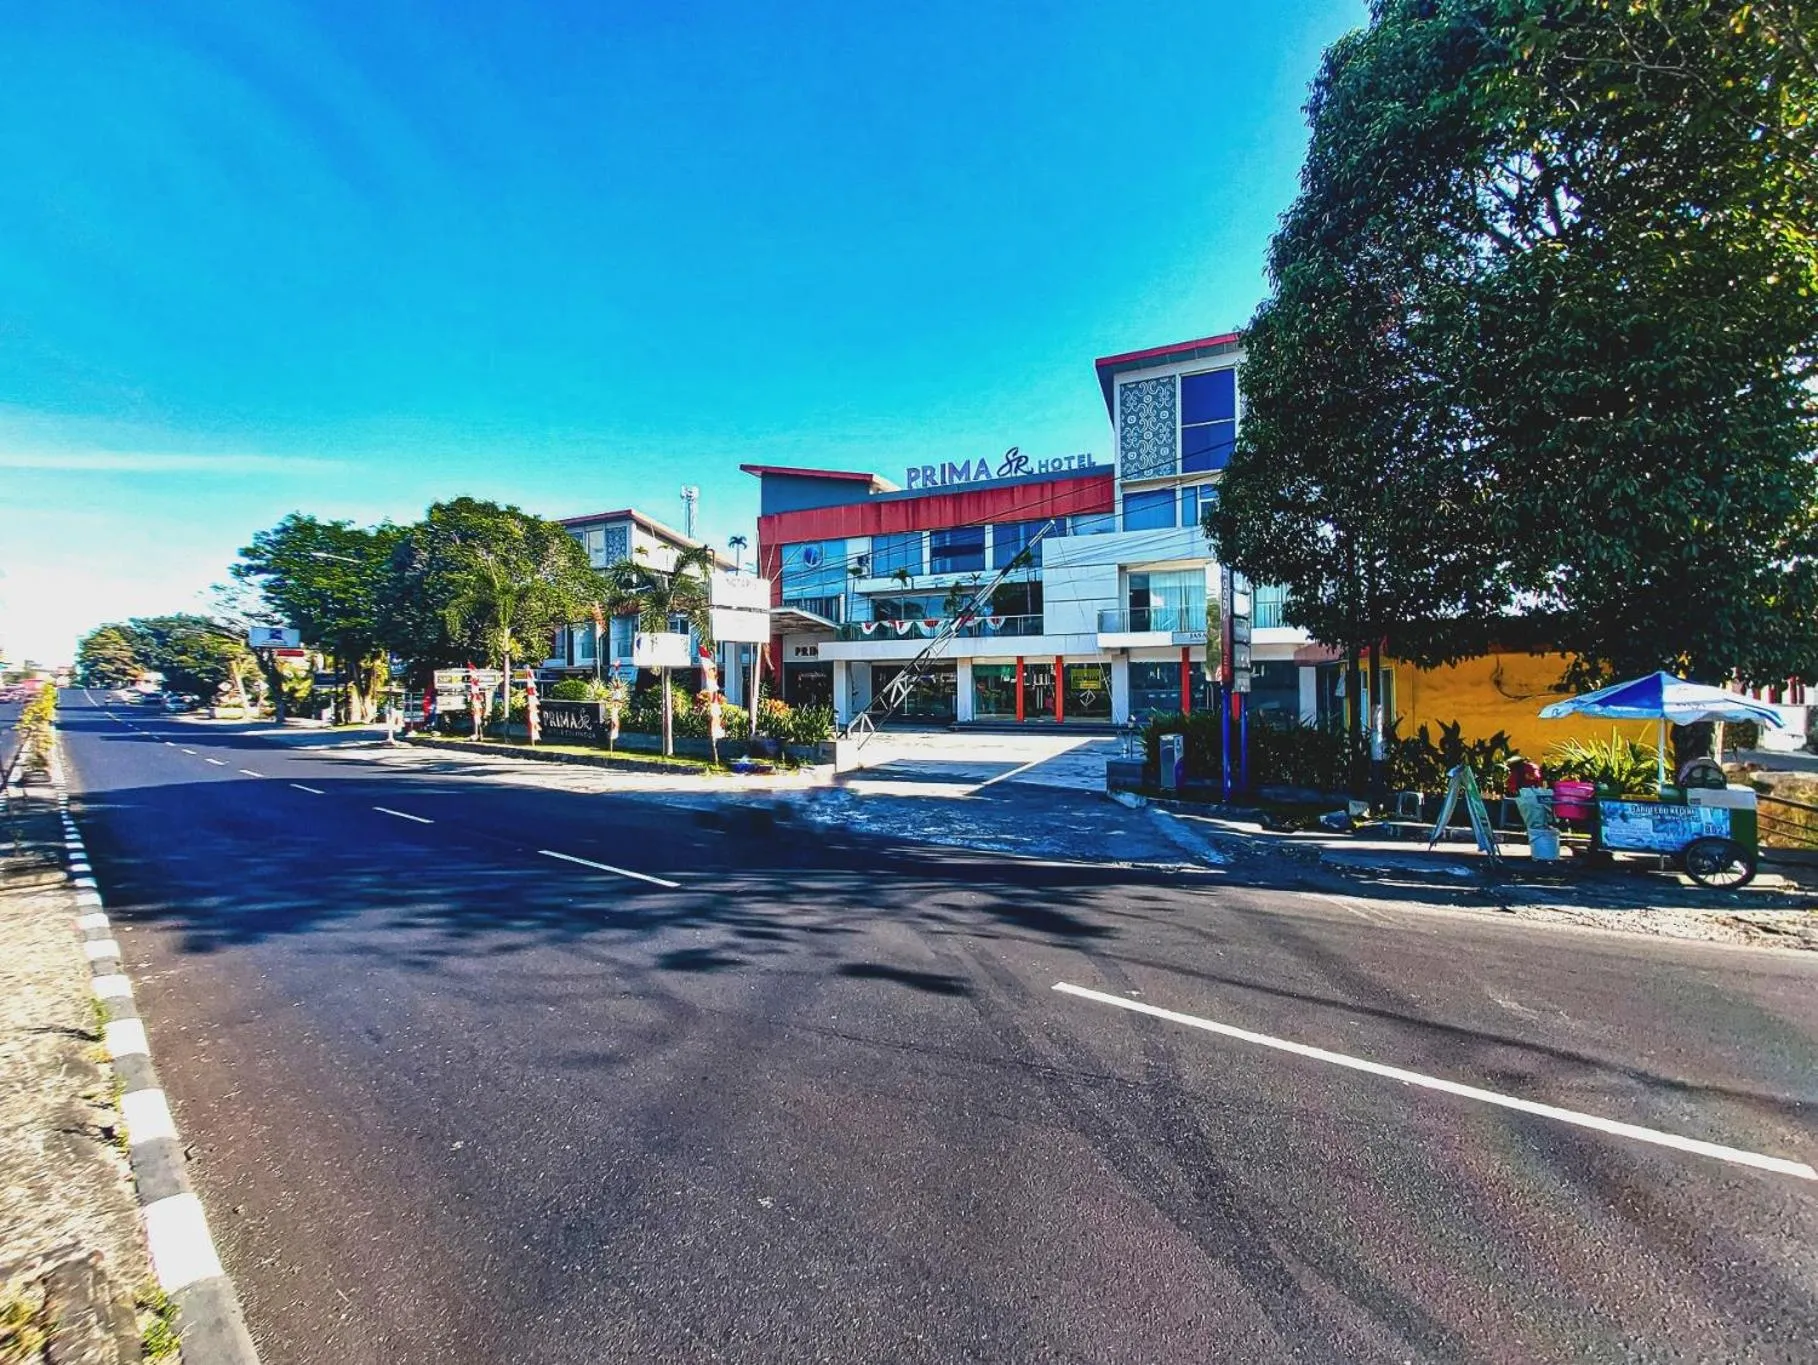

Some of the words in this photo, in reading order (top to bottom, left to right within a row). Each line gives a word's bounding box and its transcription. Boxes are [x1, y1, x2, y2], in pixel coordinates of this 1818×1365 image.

[906, 457, 992, 490] PRIMA
[1038, 453, 1096, 474] HOTEL
[543, 711, 577, 728] PRIMA
